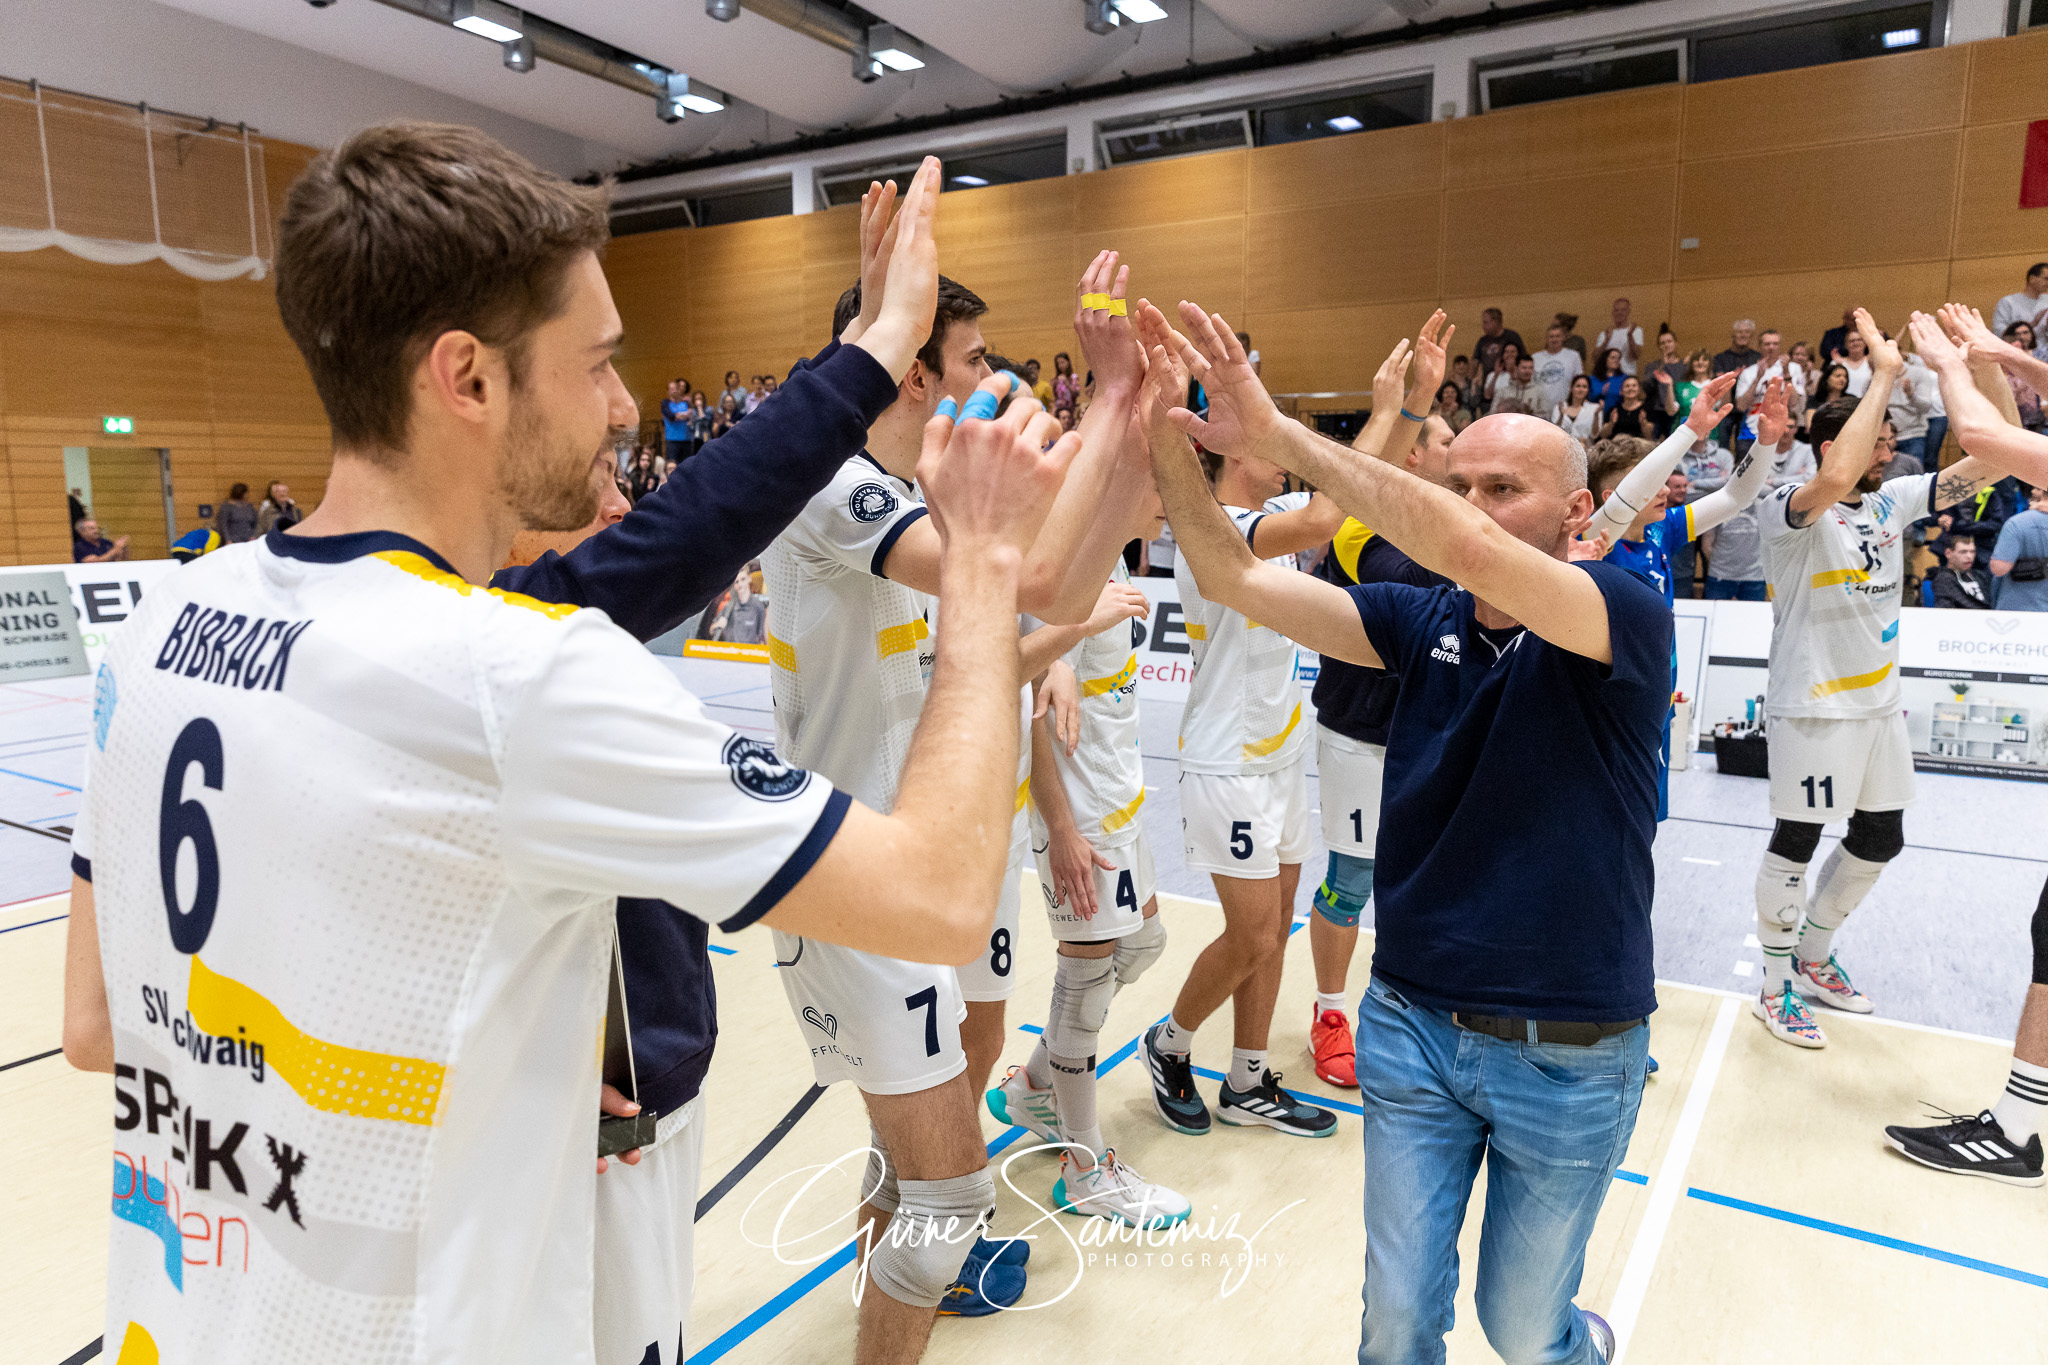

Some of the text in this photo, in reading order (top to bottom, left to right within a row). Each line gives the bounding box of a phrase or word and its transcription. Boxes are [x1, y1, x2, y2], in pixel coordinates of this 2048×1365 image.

[155, 602, 314, 692] BIBRACK
[1801, 775, 1834, 808] 11
[159, 717, 225, 955] 6
[1229, 820, 1254, 860] 5
[1349, 808, 1363, 843] 1
[1116, 868, 1138, 913] 4
[990, 927, 1012, 977] 8
[142, 984, 170, 1028] SV
[904, 984, 941, 1058] 7
[114, 1062, 251, 1197] SPK
